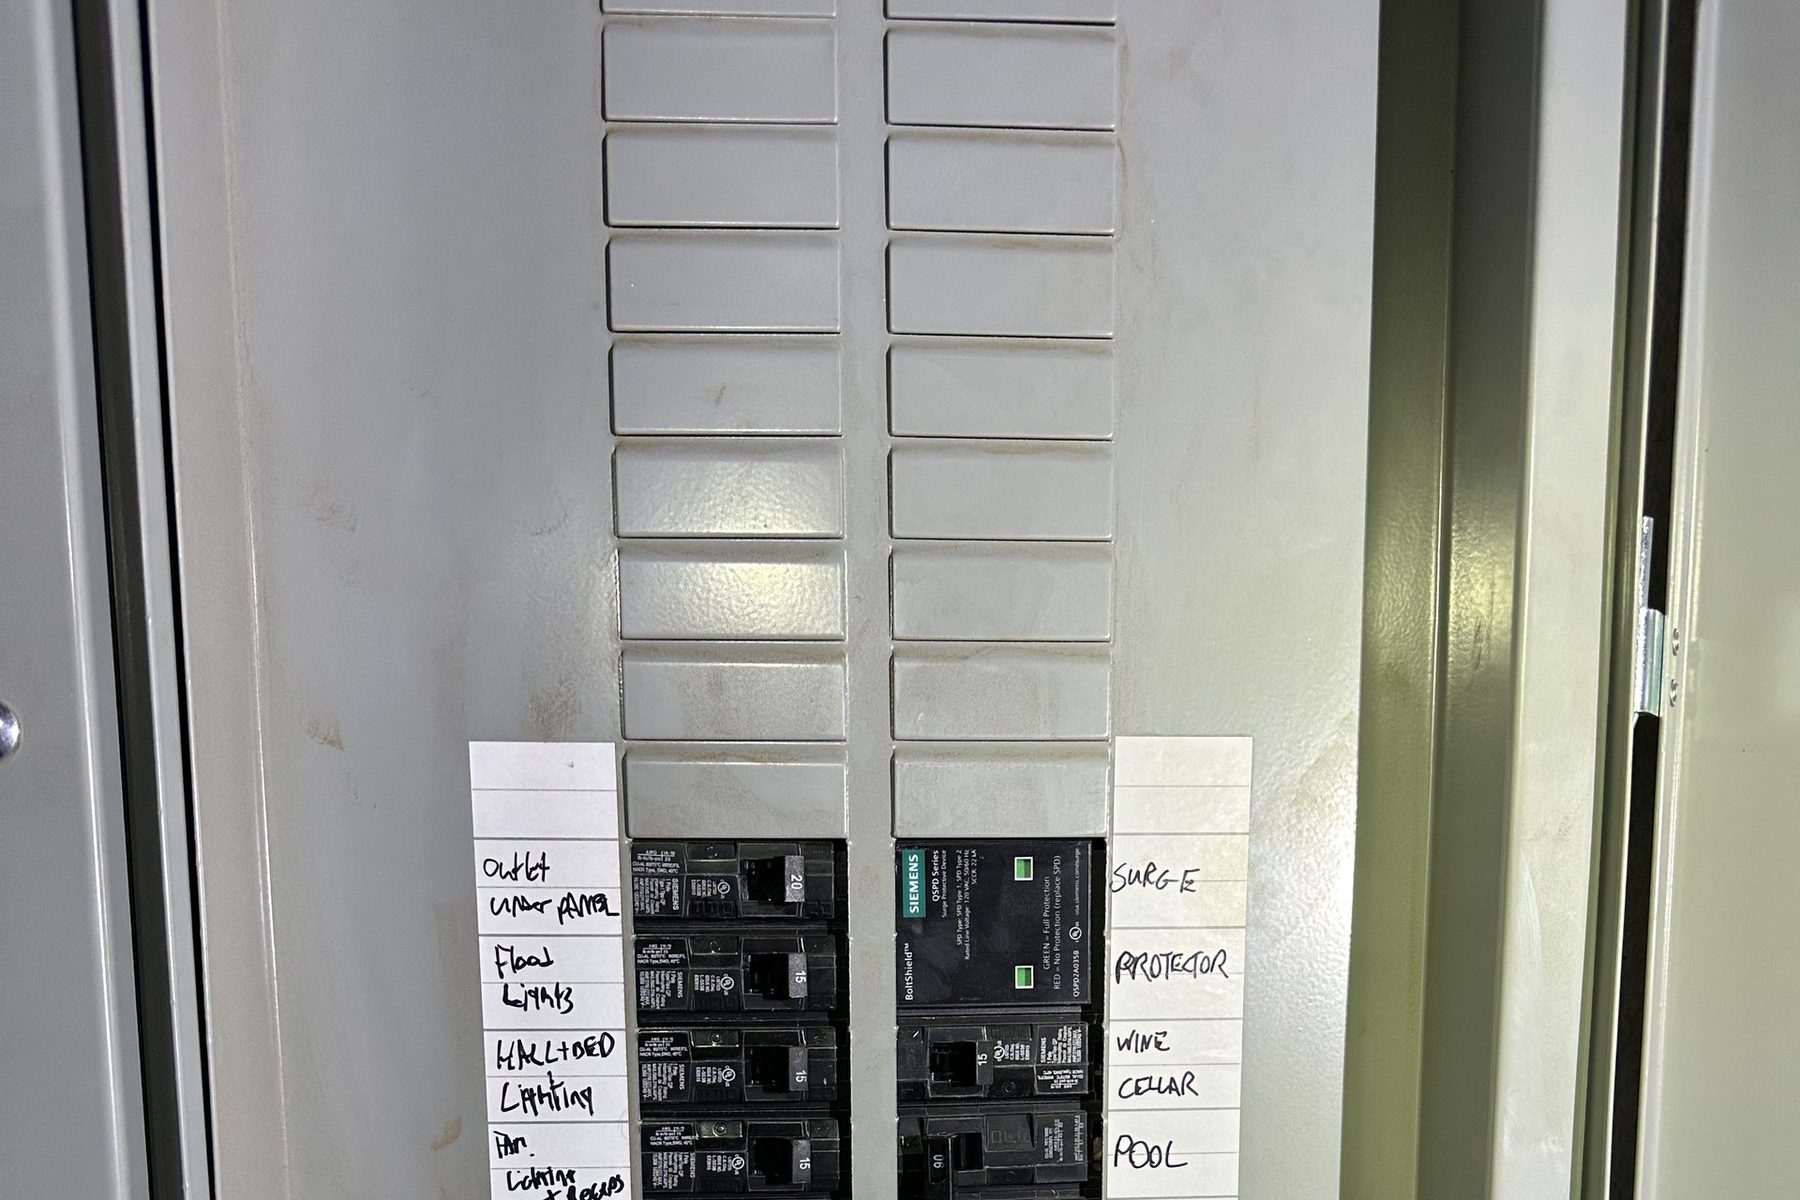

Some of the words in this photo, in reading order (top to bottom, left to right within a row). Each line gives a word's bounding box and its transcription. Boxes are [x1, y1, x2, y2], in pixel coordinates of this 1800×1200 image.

[932, 850, 940, 876] Series
[791, 874, 802, 890] 20
[909, 855, 919, 913] SIEMENS
[1109, 861, 1200, 893] SURGE
[932, 878, 940, 901] QSPD
[1054, 876, 1062, 909] (replace
[1054, 953, 1061, 964] No
[795, 970, 807, 983] 15
[1117, 1030, 1170, 1053] WINE
[977, 1053, 988, 1066] 15
[795, 1070, 807, 1083] 15
[1118, 1071, 1199, 1099] CELLAR
[1114, 1134, 1188, 1169] POOL
[800, 1157, 811, 1170] 15
